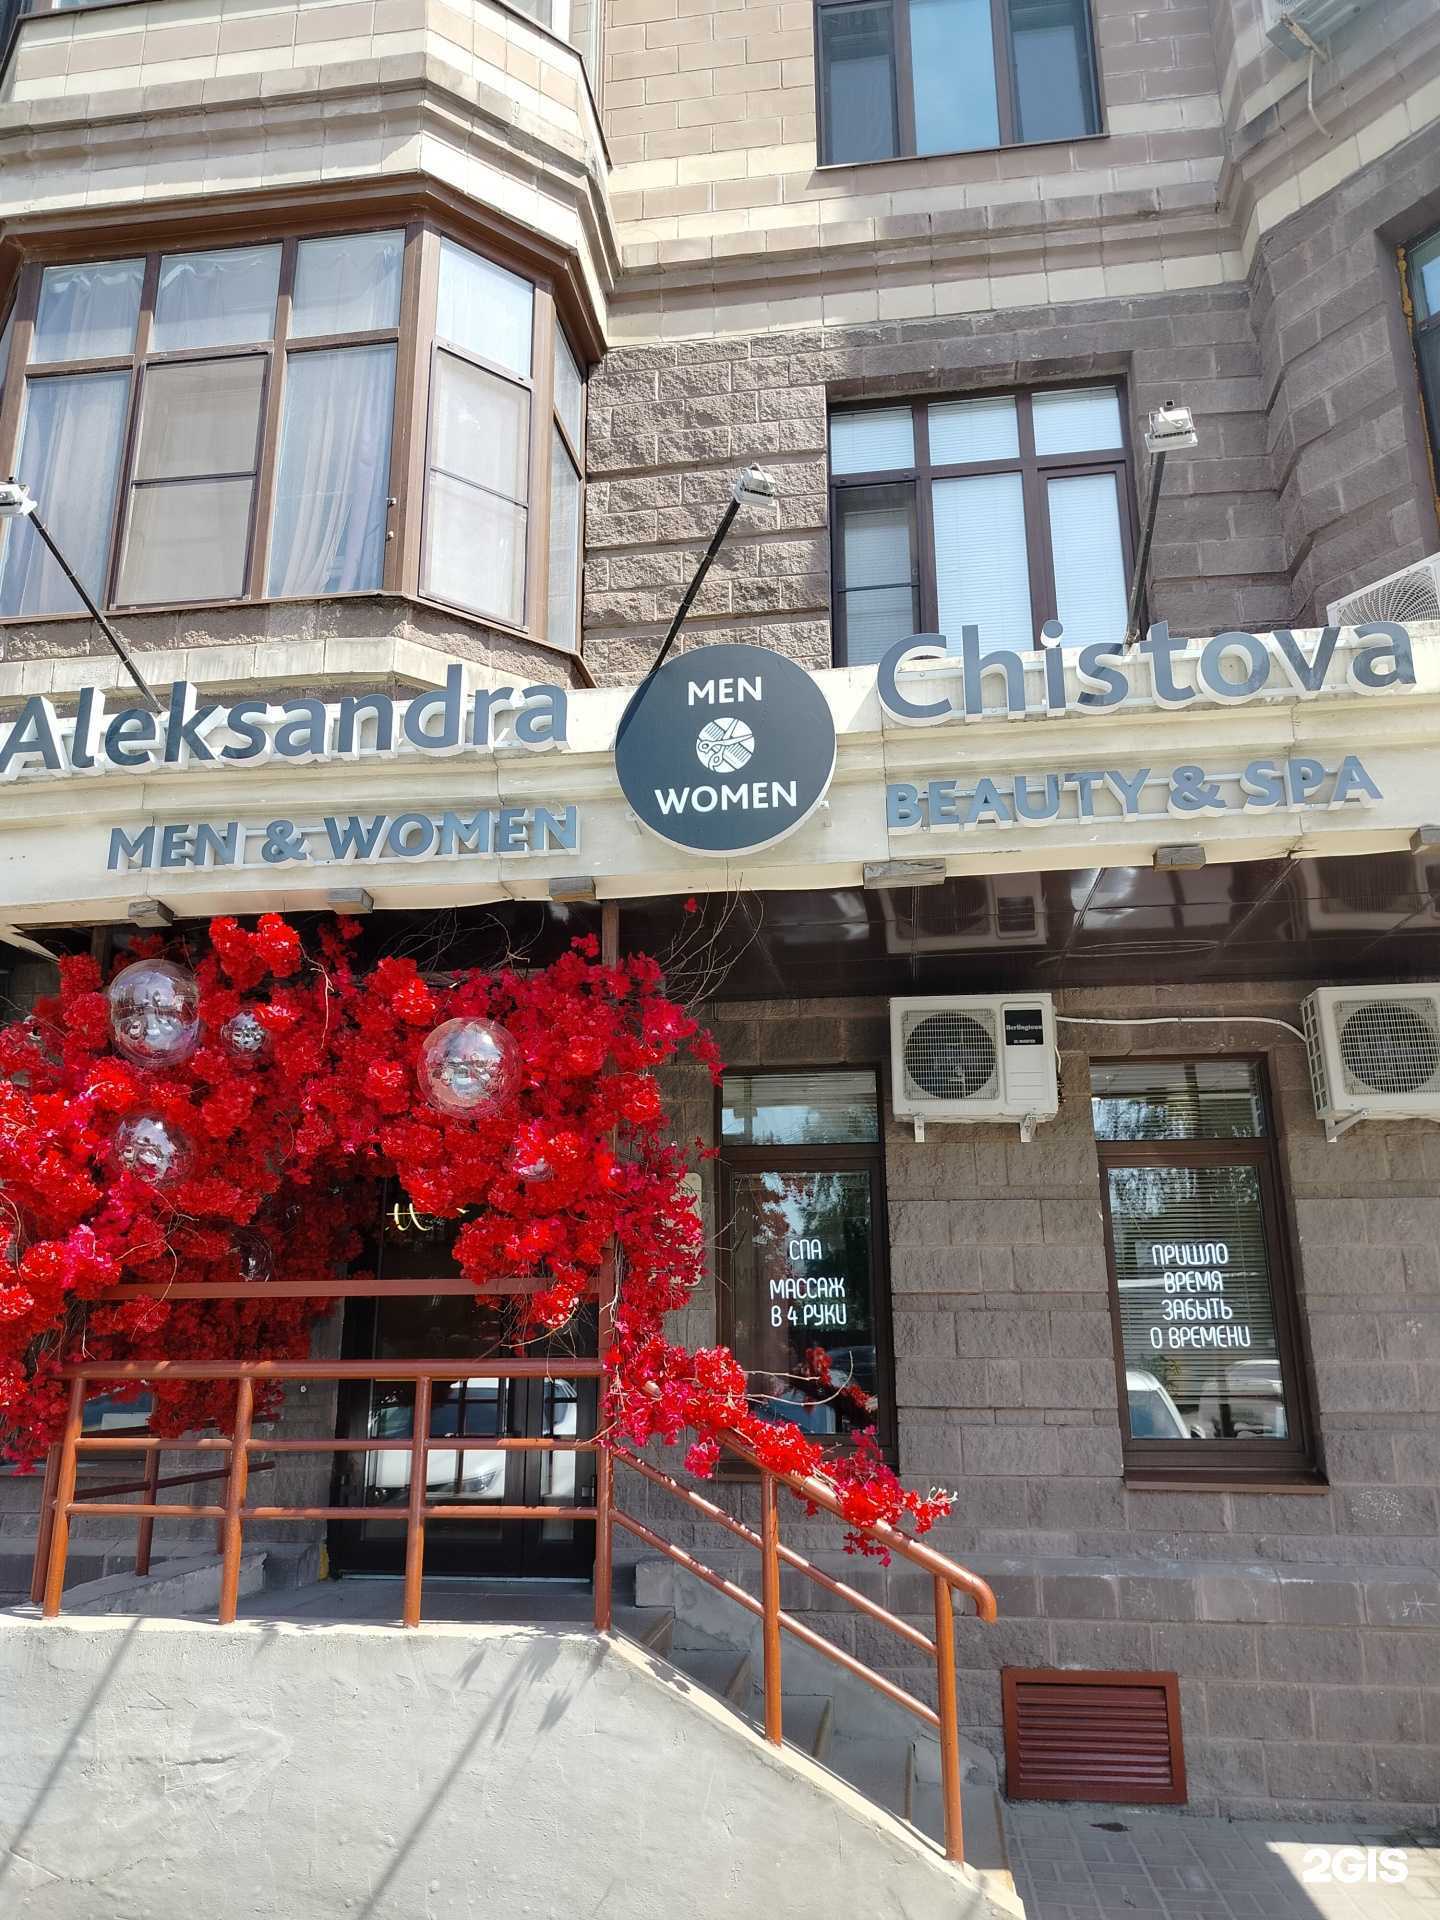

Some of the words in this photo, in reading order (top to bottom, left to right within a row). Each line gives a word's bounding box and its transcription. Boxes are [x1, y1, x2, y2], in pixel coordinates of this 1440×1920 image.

[877, 620, 1417, 720] Chistova
[688, 676, 762, 705] MEN
[0, 664, 569, 775] Aleksandra
[654, 781, 797, 815] WOMEN
[887, 768, 1150, 829] BEAUTY
[1170, 765, 1225, 811] &
[1243, 755, 1384, 808] SPA
[107, 821, 240, 870] MEN
[261, 820, 304, 864] &
[323, 806, 578, 860] WOMEN
[789, 1239, 822, 1260] СПА
[1152, 1243, 1229, 1265] ПРИШЛО
[769, 1277, 846, 1300] МАССАЖ
[1164, 1271, 1224, 1293] ВРЕМЯ
[771, 1305, 782, 1327] В
[787, 1306, 798, 1326] 4
[803, 1303, 847, 1326] РУКИ
[1161, 1298, 1233, 1320] ЗАБЫТЬ
[1150, 1327, 1163, 1348] О
[1168, 1325, 1251, 1348] ВРЕМЕНИ
